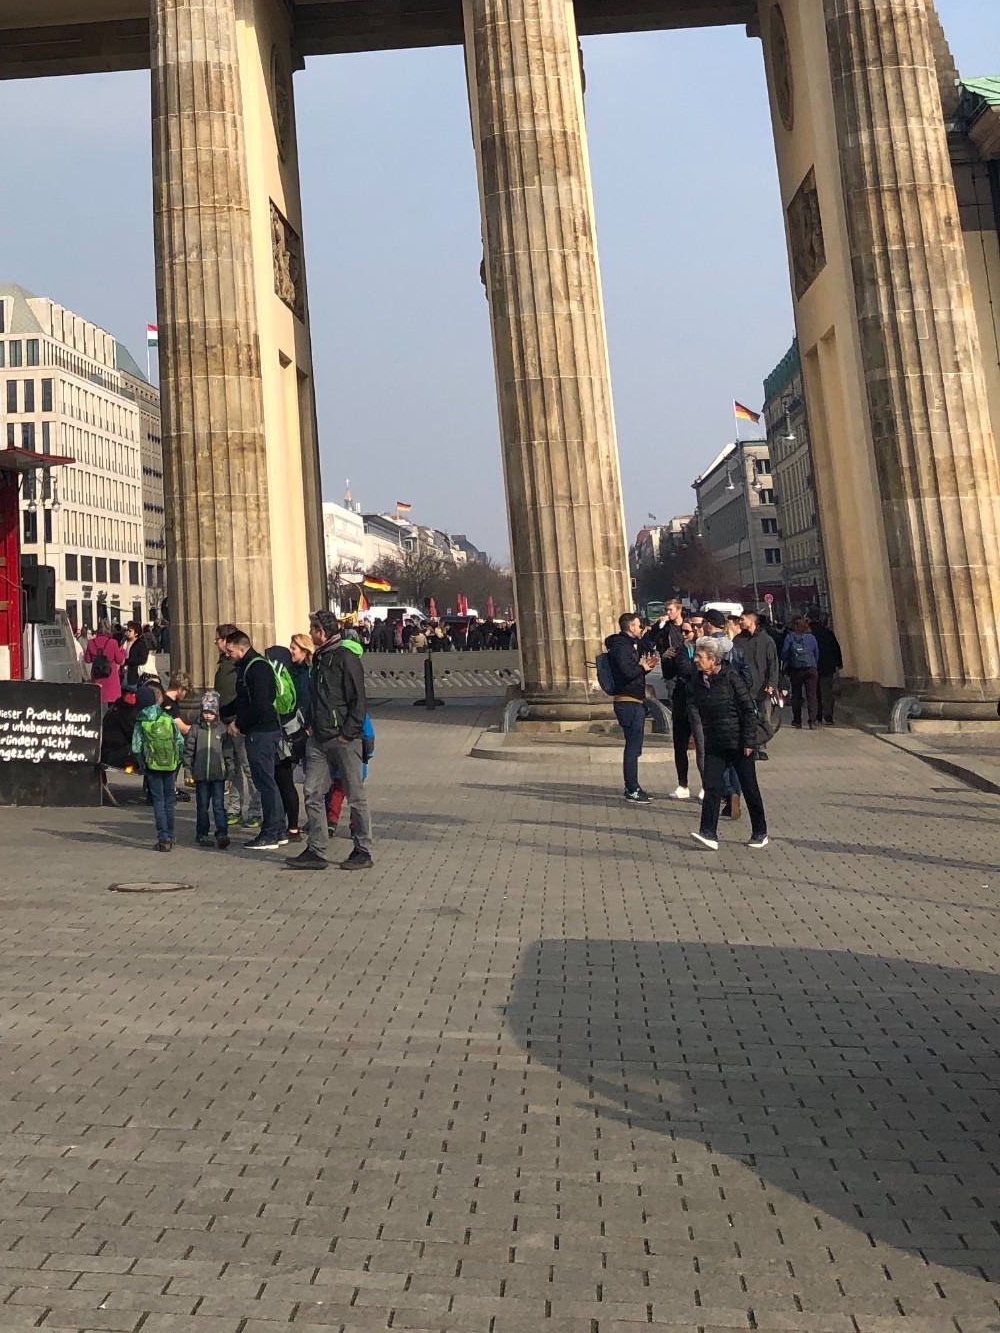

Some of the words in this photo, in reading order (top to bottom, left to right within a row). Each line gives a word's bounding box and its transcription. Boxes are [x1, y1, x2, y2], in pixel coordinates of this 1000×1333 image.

[26, 707, 62, 721] Protest
[65, 709, 91, 722] kann
[41, 736, 71, 749] nicht
[49, 752, 88, 762] werden.
